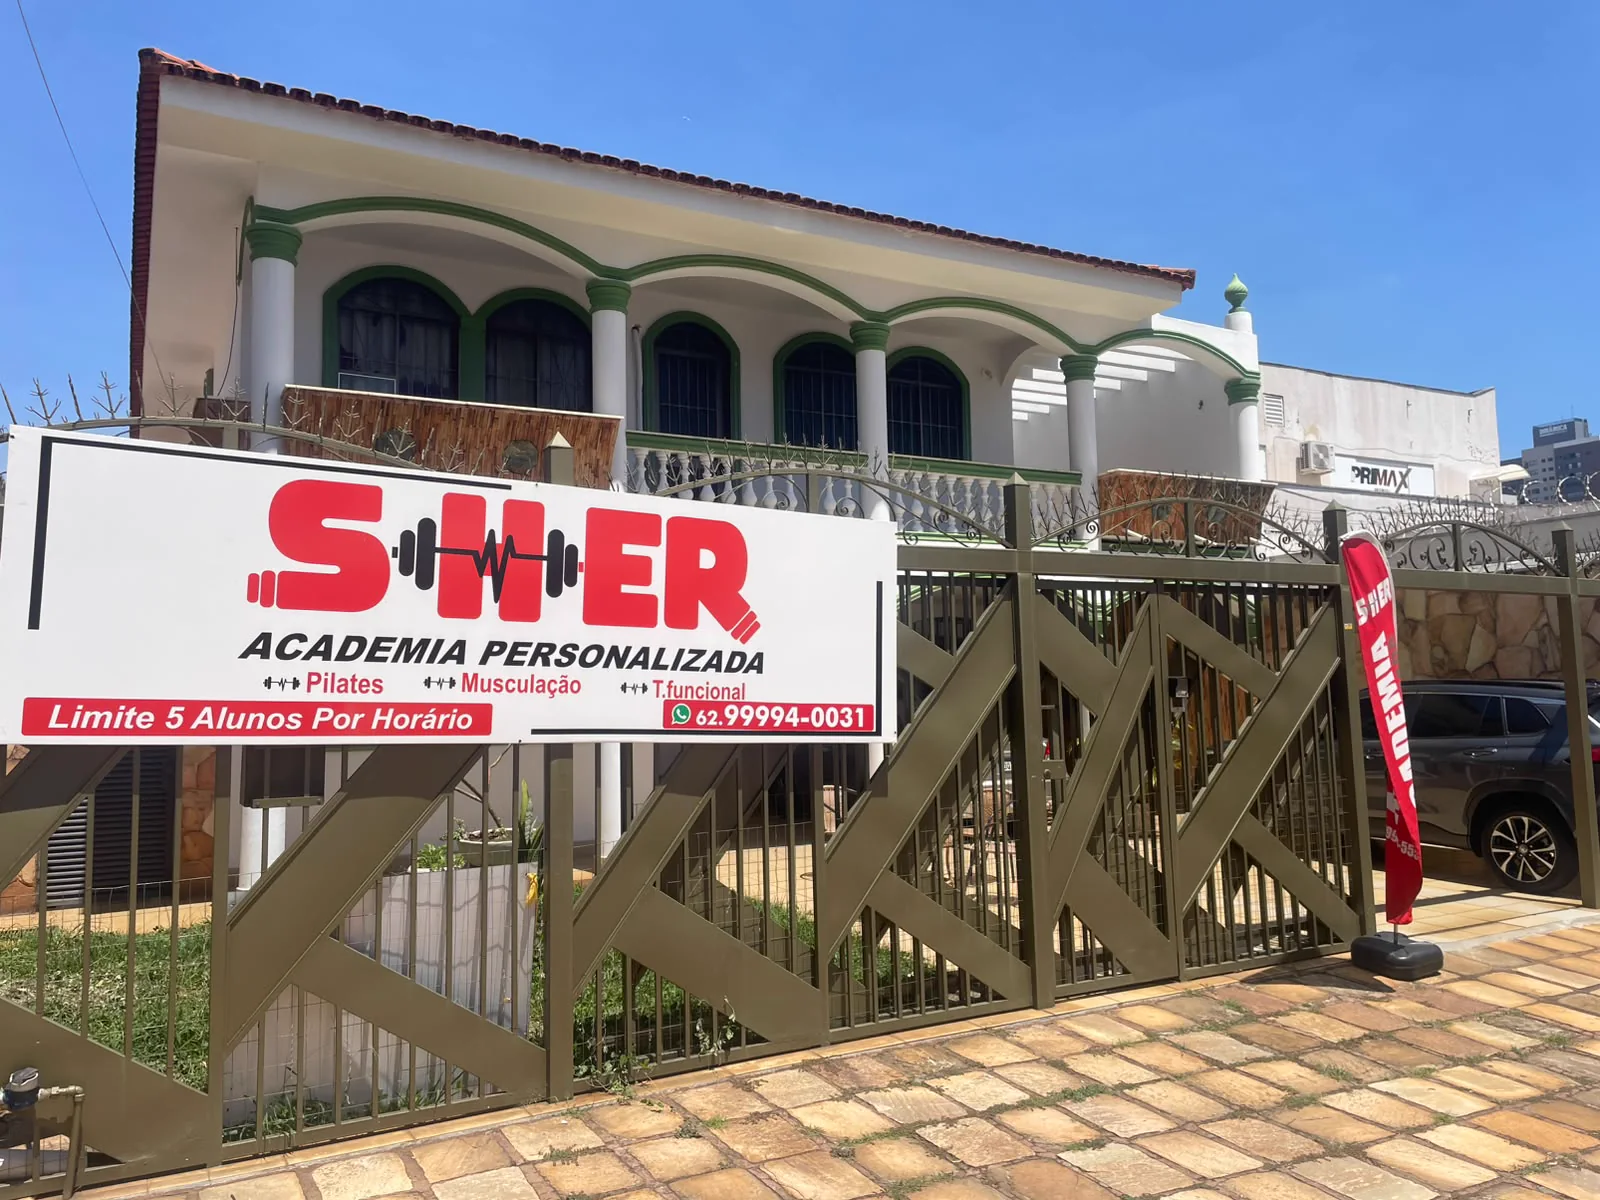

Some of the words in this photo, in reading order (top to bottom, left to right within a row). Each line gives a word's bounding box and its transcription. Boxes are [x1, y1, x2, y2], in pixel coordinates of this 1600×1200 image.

[1351, 466, 1412, 493] PRIMAX
[247, 479, 762, 645] SHER
[1355, 577, 1393, 627] SHER
[237, 632, 467, 665] ACADEMIA
[478, 640, 764, 675] PERSONALIZADA
[306, 671, 384, 695] Pilates
[461, 672, 582, 699] Musculação
[652, 679, 746, 701] T.funcional
[48, 704, 155, 730] Limite
[165, 706, 185, 730] 5
[190, 706, 303, 730] Alunos
[311, 707, 366, 730] Por
[371, 707, 473, 731] Horário
[695, 703, 865, 729] 62.99994-0031
